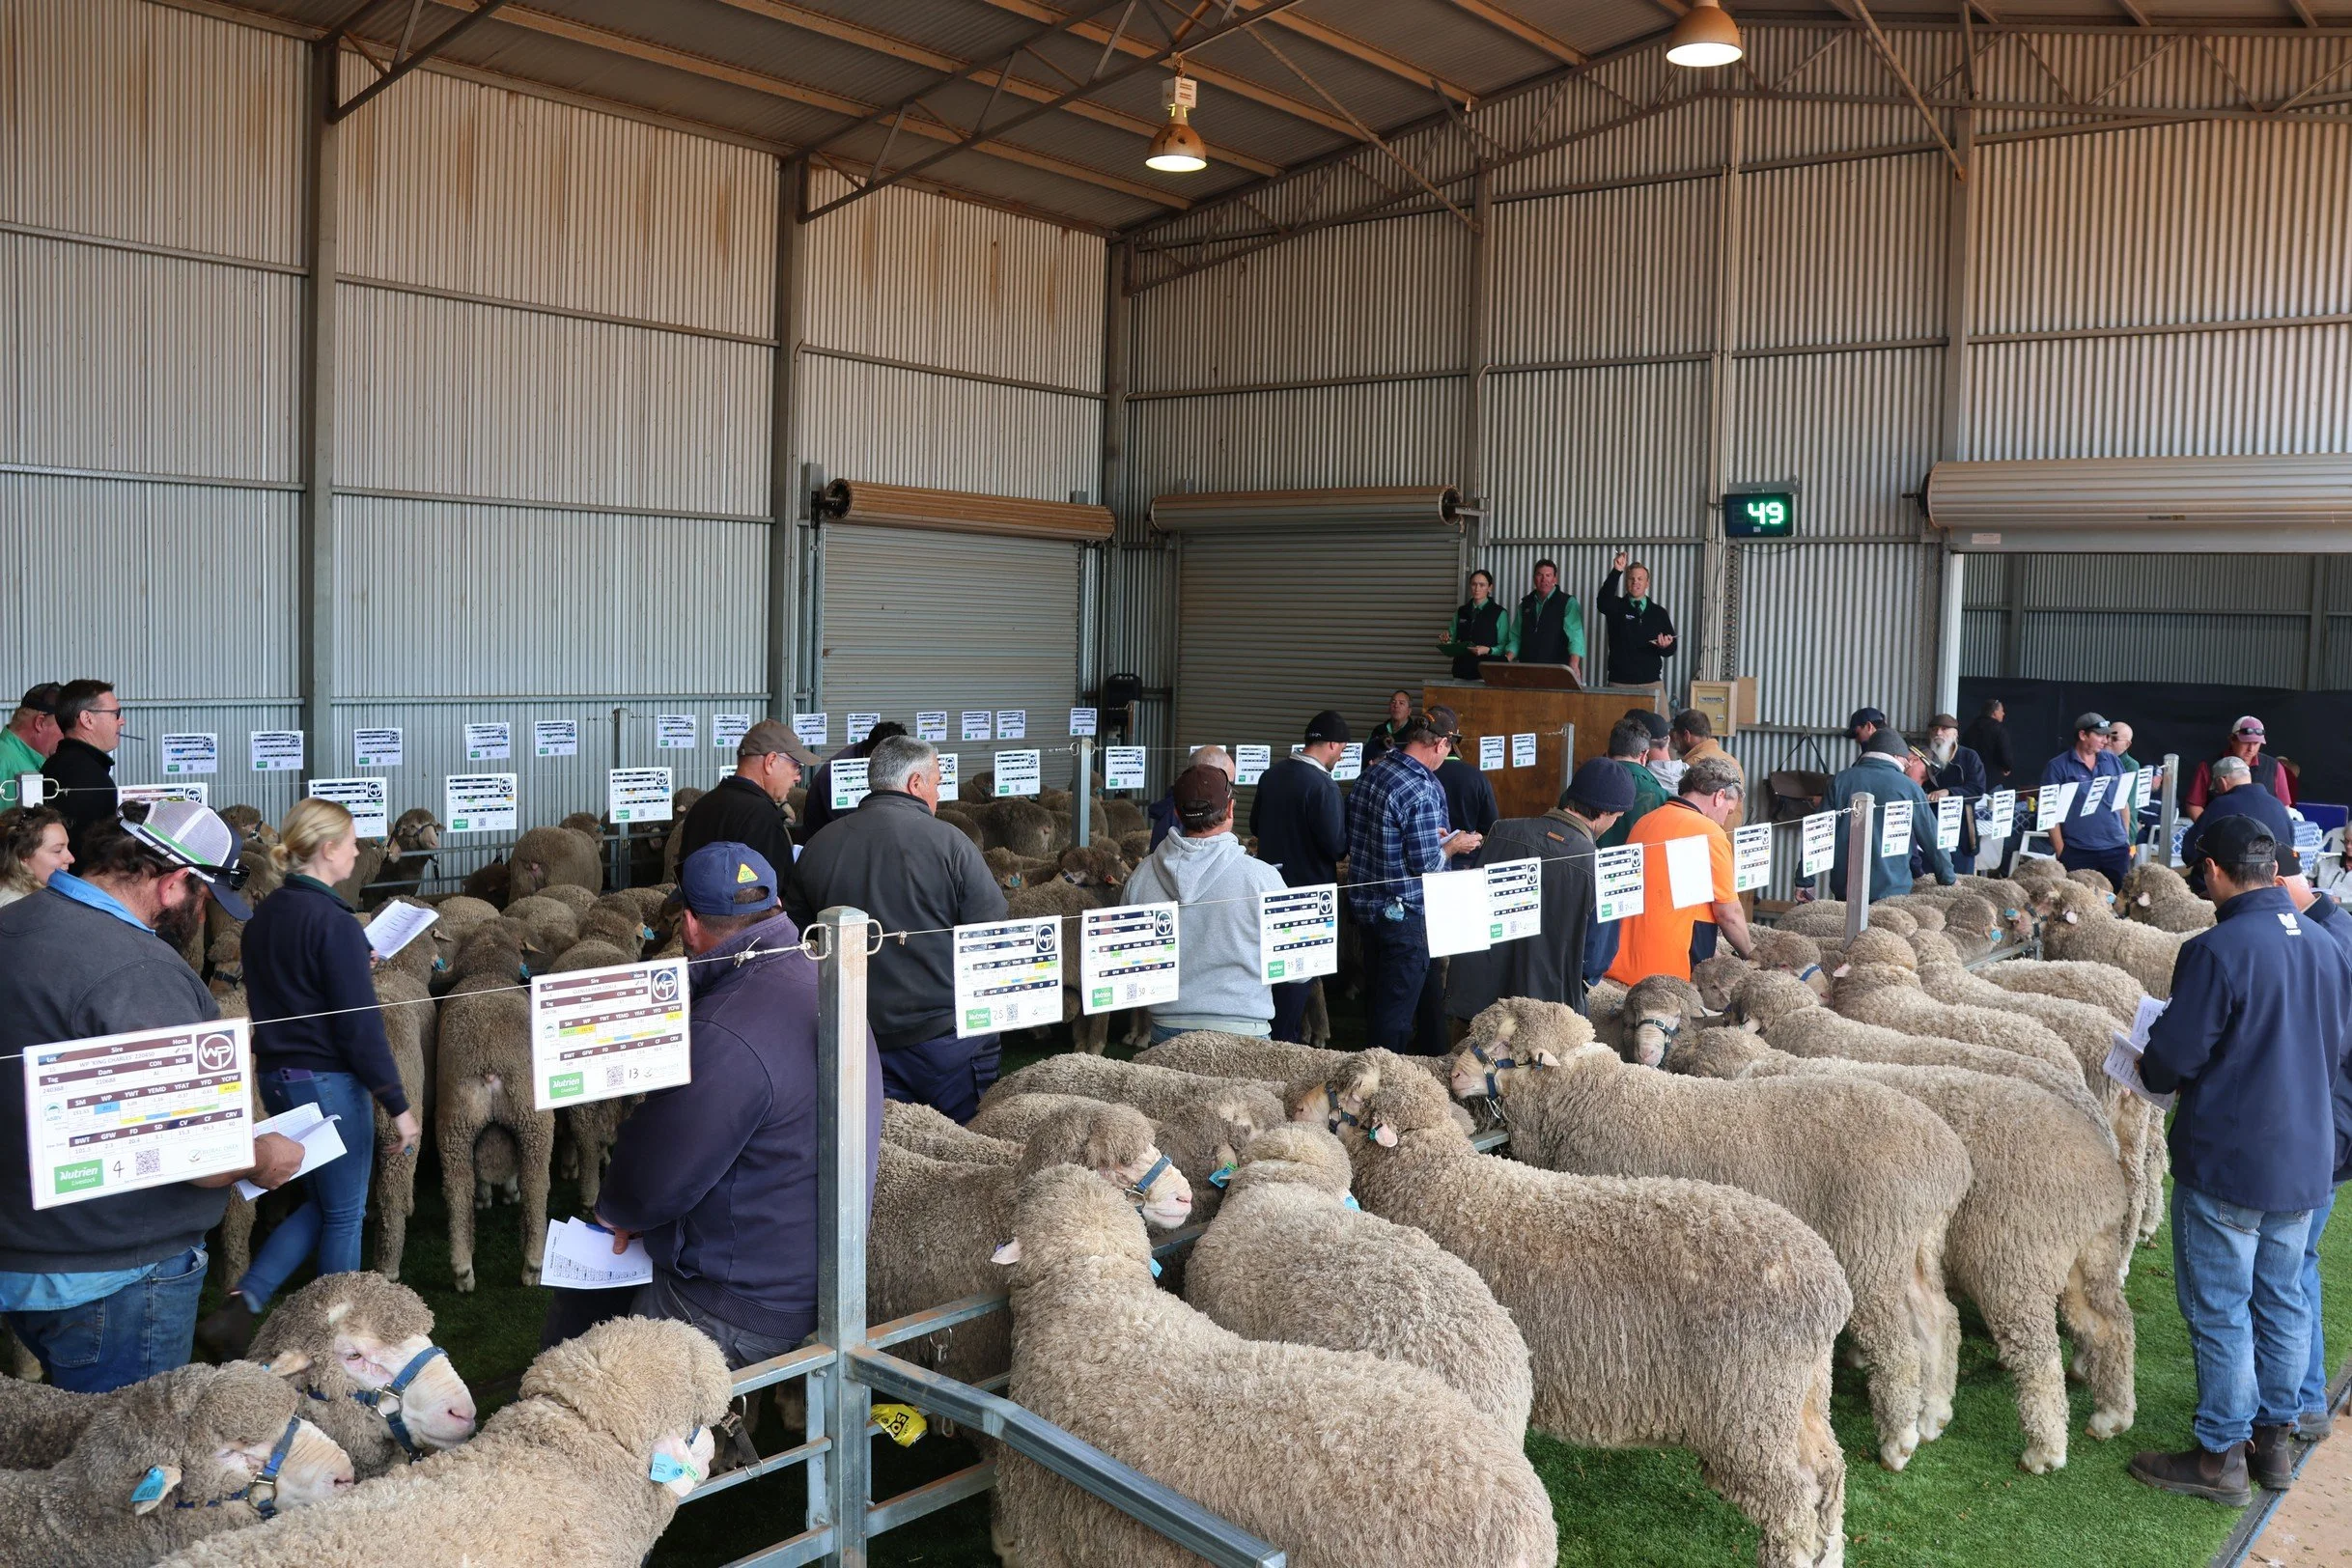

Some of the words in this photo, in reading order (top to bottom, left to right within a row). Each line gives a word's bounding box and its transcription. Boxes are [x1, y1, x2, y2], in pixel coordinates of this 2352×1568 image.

[1747, 501, 1784, 524] 49
[630, 1068, 638, 1079] 13
[552, 1078, 579, 1089] Nutrien
[60, 1166, 98, 1181] Nutrien
[113, 1160, 126, 1178] 4
[71, 1177, 96, 1186] Livestock
